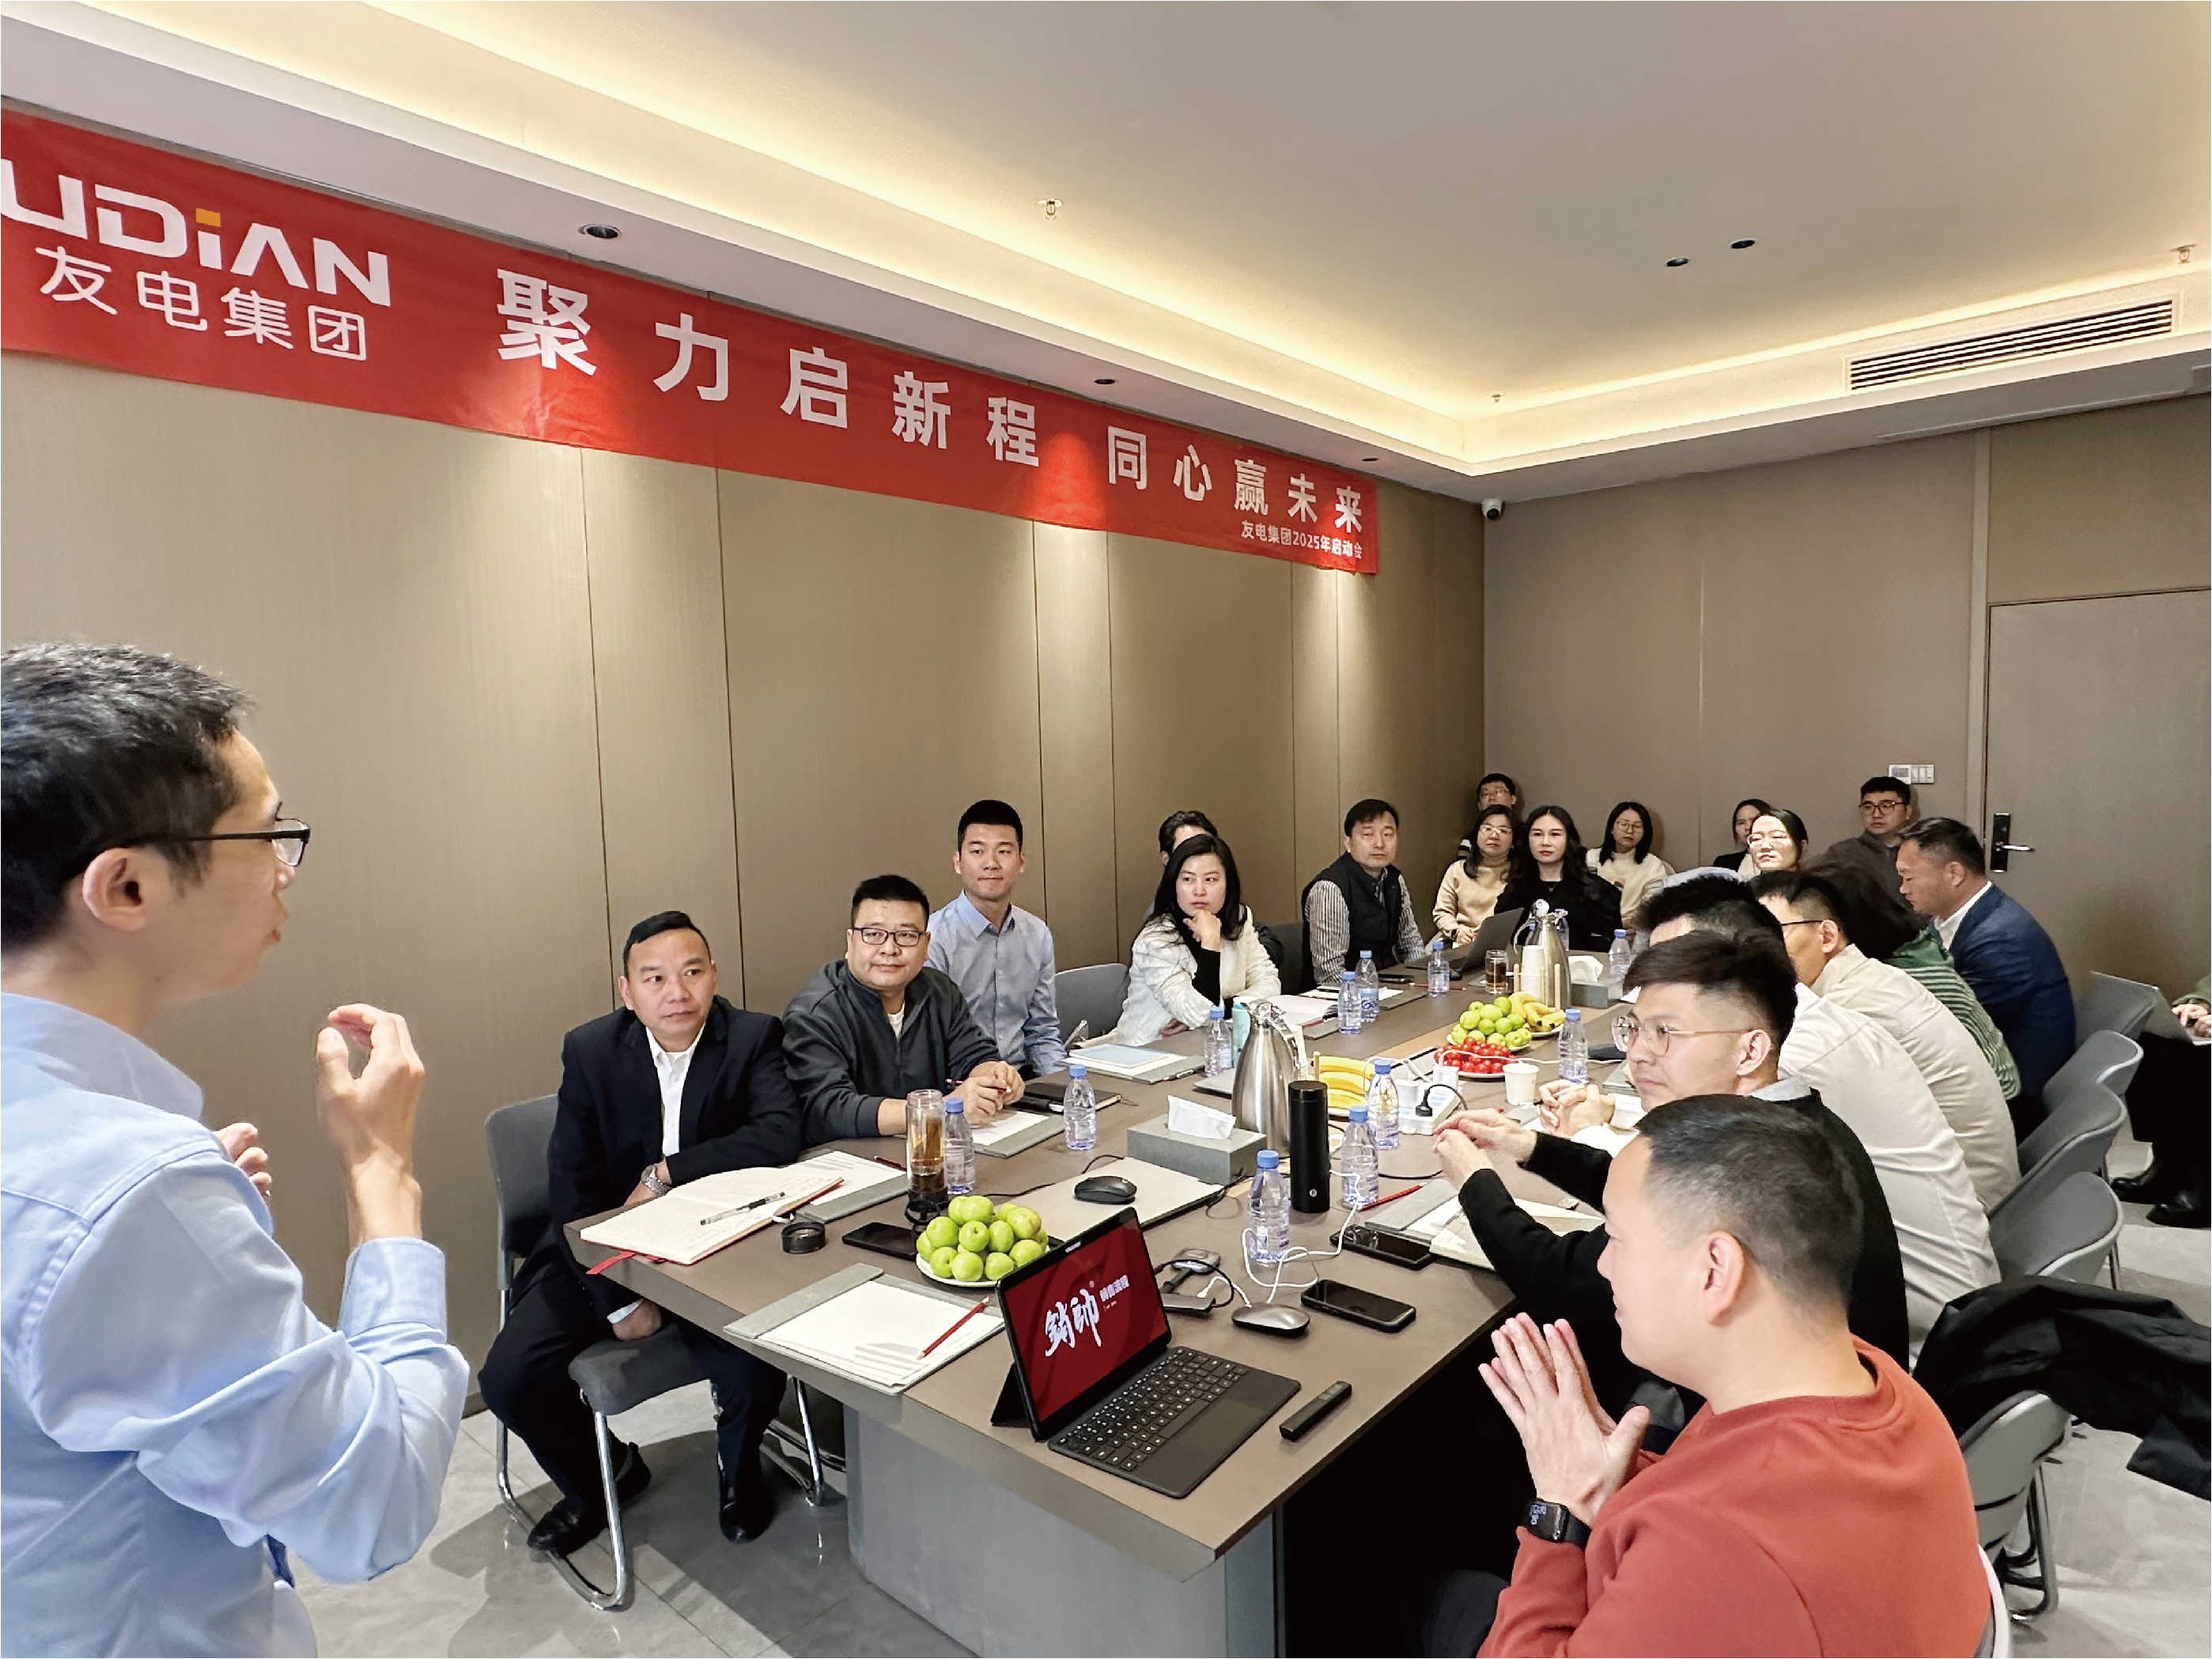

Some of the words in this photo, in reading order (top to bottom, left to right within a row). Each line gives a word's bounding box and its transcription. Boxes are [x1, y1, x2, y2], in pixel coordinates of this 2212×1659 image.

[35, 246, 367, 361] 友电集团
[497, 268, 1039, 467] 聚力启新程
[1107, 425, 1363, 533] 同心赢未来
[1241, 520, 1363, 560] 友电集团2025年启动会
